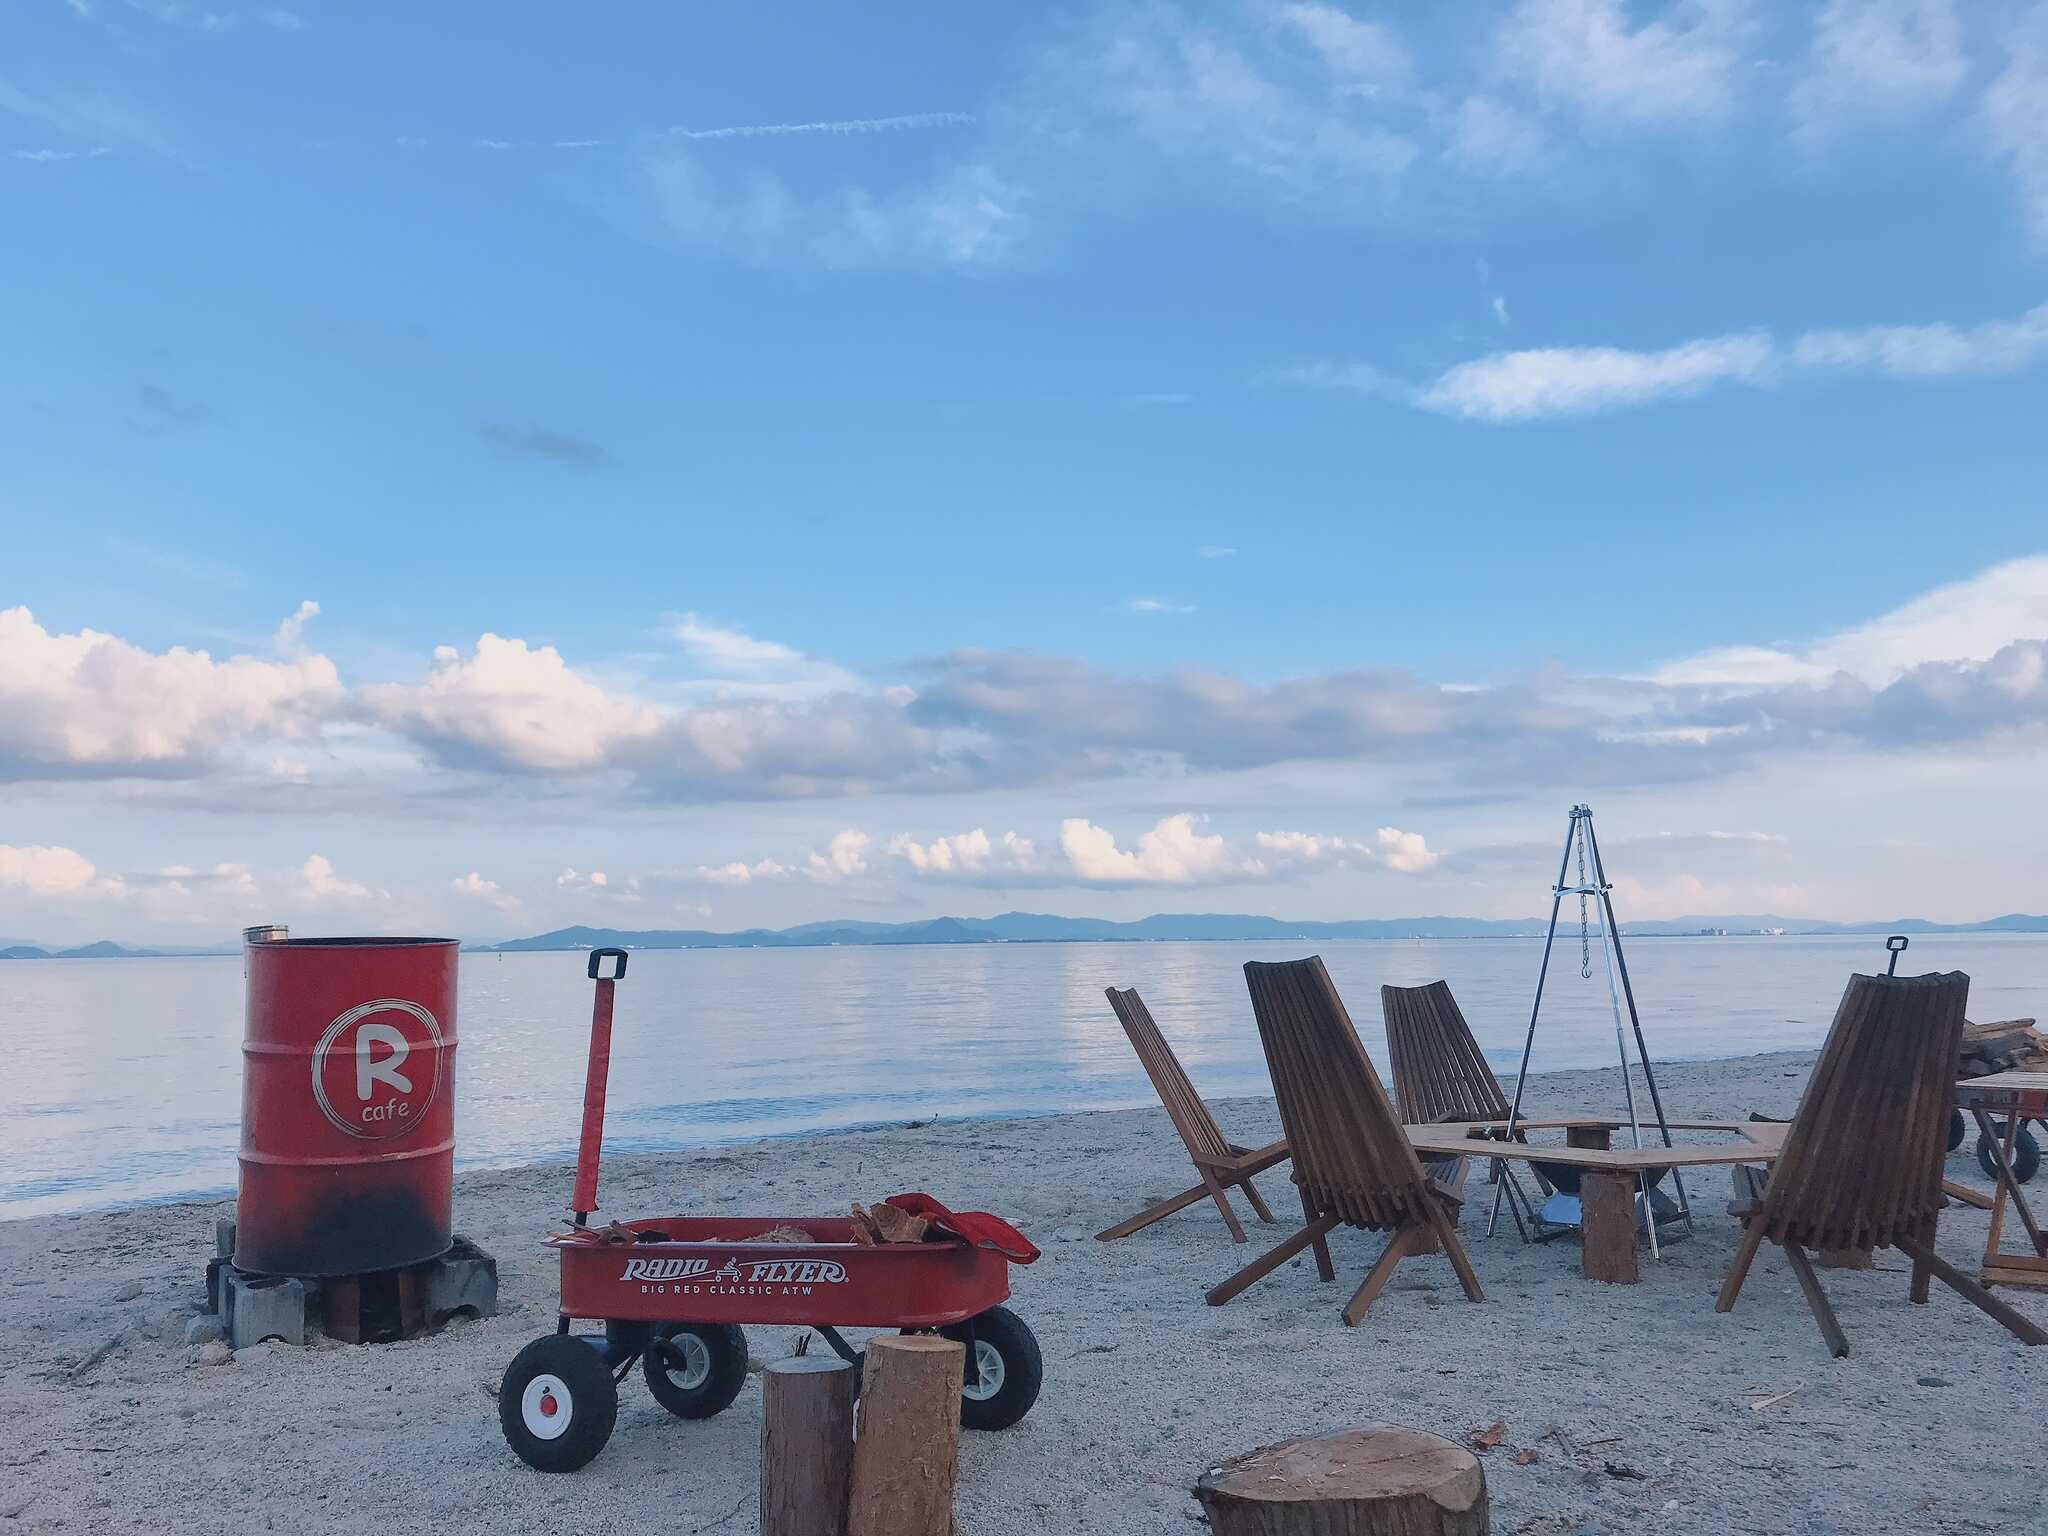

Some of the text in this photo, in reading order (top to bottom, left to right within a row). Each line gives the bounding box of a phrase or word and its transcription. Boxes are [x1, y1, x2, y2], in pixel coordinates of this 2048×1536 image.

[355, 1023, 413, 1101] R
[361, 1099, 410, 1123] cafe
[619, 1257, 848, 1284] RADIO FLYER
[641, 1285, 813, 1296] BIG RED CLASSIC ATW
